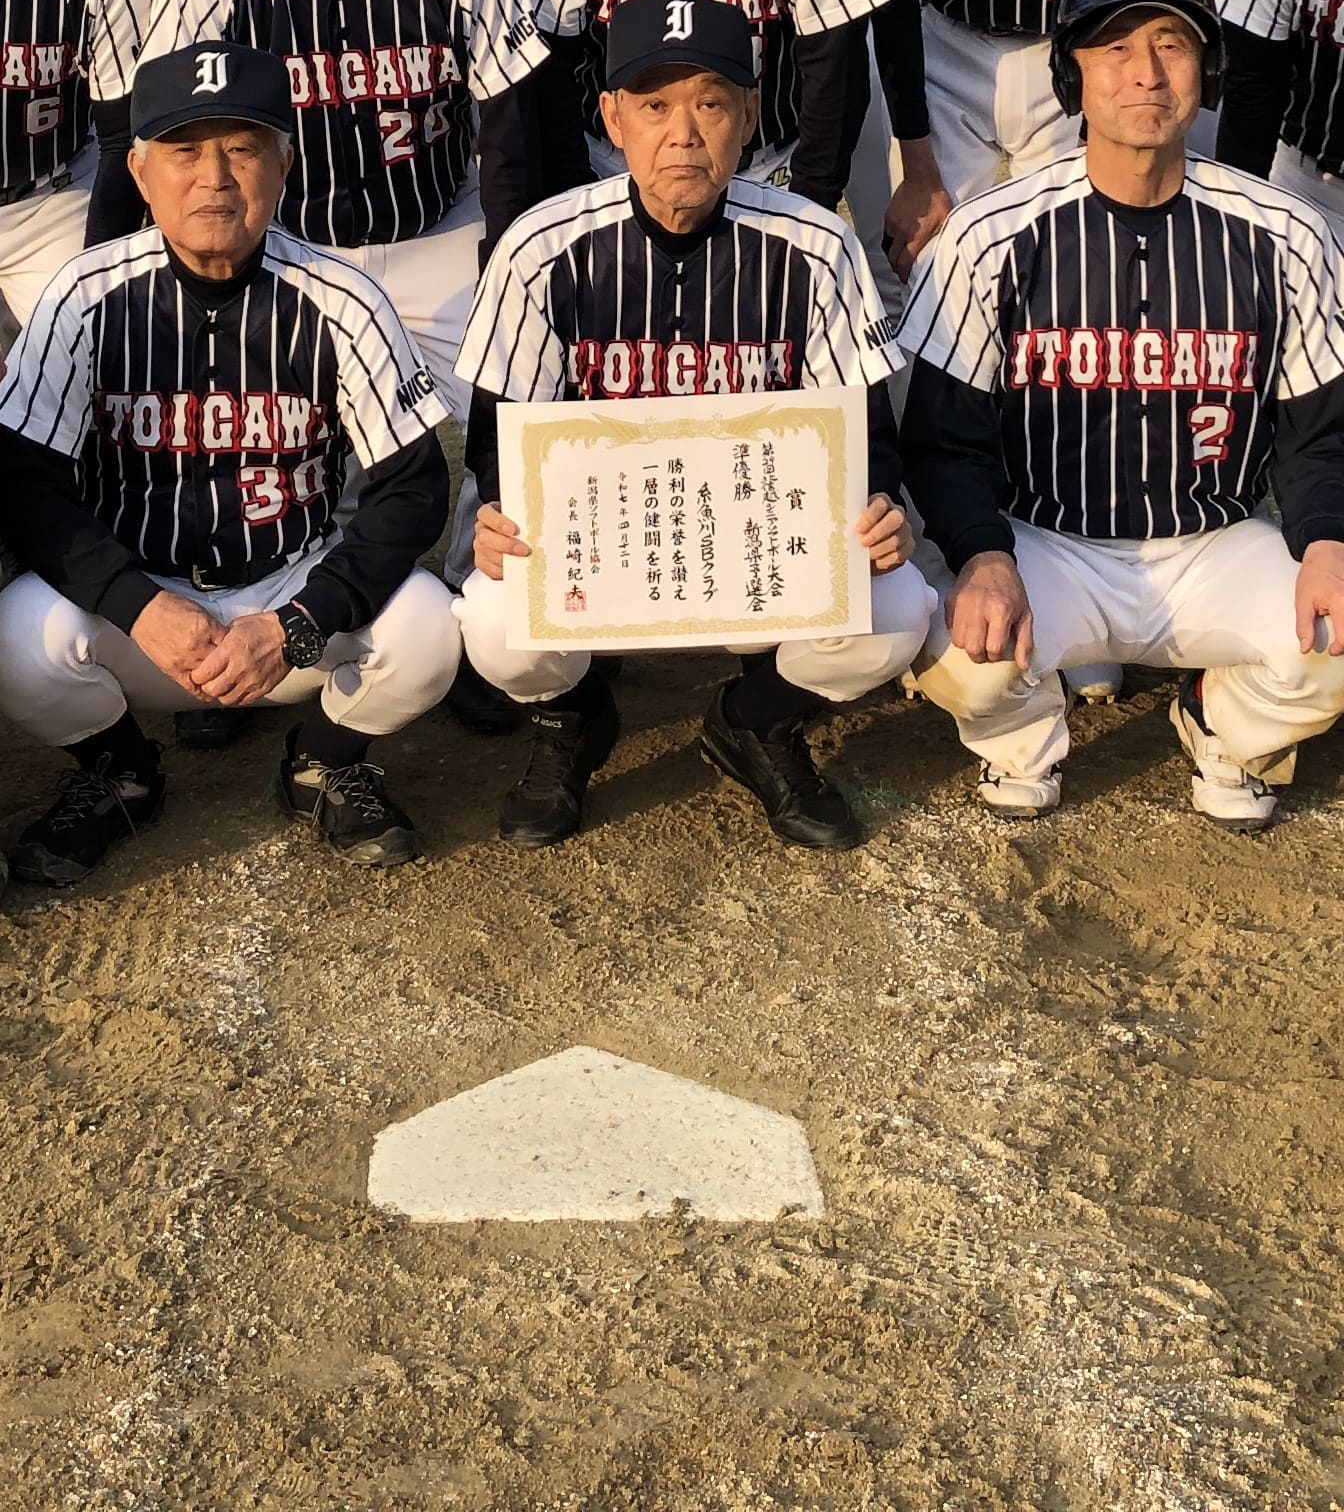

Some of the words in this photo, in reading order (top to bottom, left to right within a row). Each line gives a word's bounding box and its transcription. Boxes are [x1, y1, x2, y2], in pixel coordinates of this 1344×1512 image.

[25, 94, 62, 136] 6
[1187, 402, 1235, 466] 2
[236, 455, 329, 526] 30
[732, 442, 757, 502] 準優勝
[566, 496, 579, 522] 会長
[642, 464, 663, 602] 一層の健闘を祈る
[667, 456, 688, 602] 勝利の栄誉を讃え
